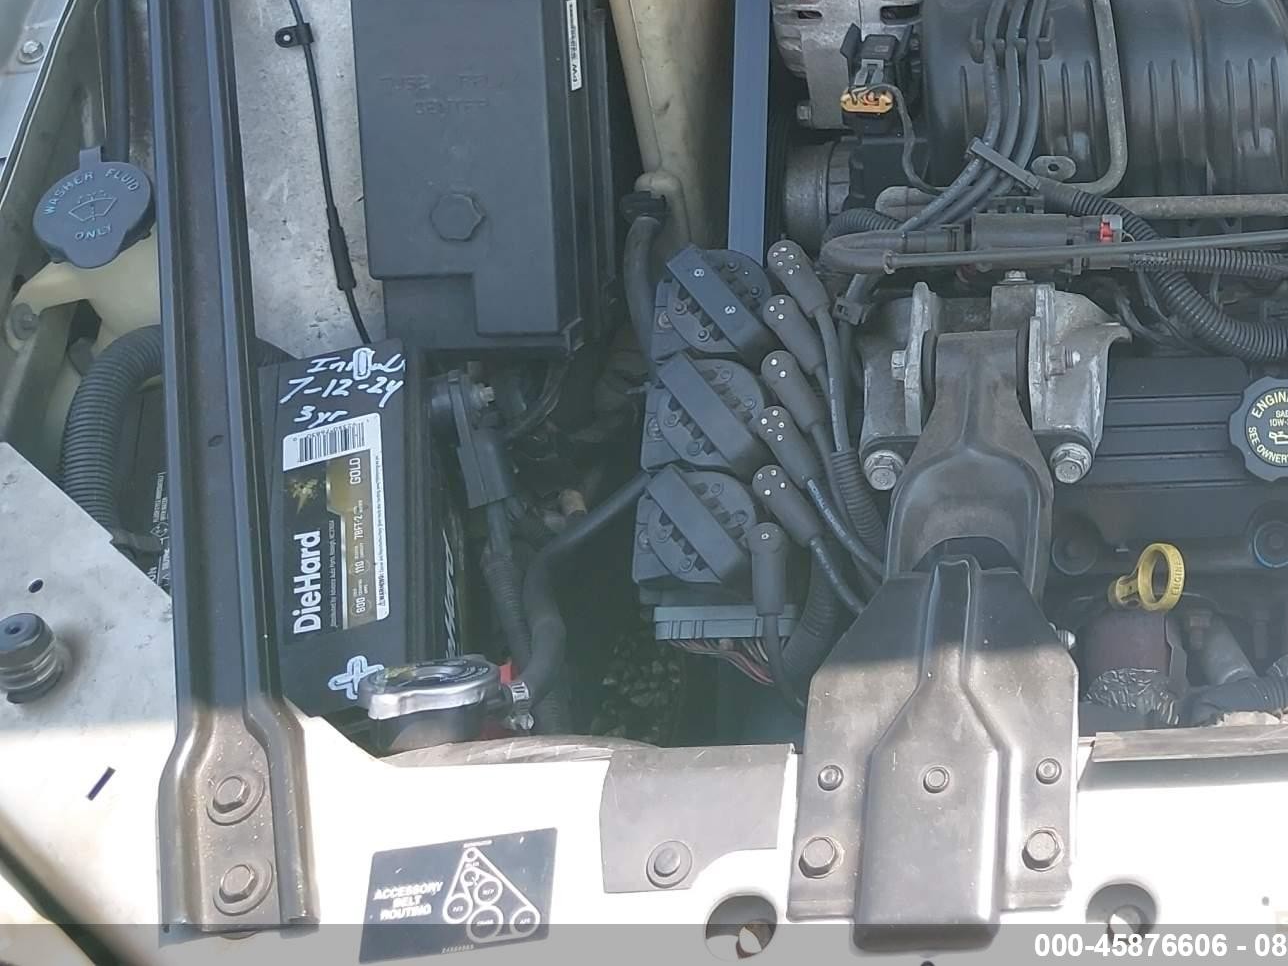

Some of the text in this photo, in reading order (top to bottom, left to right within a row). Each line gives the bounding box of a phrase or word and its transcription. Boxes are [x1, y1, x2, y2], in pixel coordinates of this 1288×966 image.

[43, 168, 140, 215] WASHER FLUID
[74, 223, 112, 240] ONLY
[725, 304, 736, 315] 3
[279, 376, 404, 408] 7-12-24
[1248, 426, 1261, 446] SEE
[349, 457, 361, 485] GOLD
[354, 558, 365, 574] 110
[293, 529, 321, 635] DieHard
[356, 596, 366, 615] 800
[373, 881, 444, 901] ACCESSORY
[392, 894, 423, 908] BELT
[380, 903, 432, 921] ROUTING
